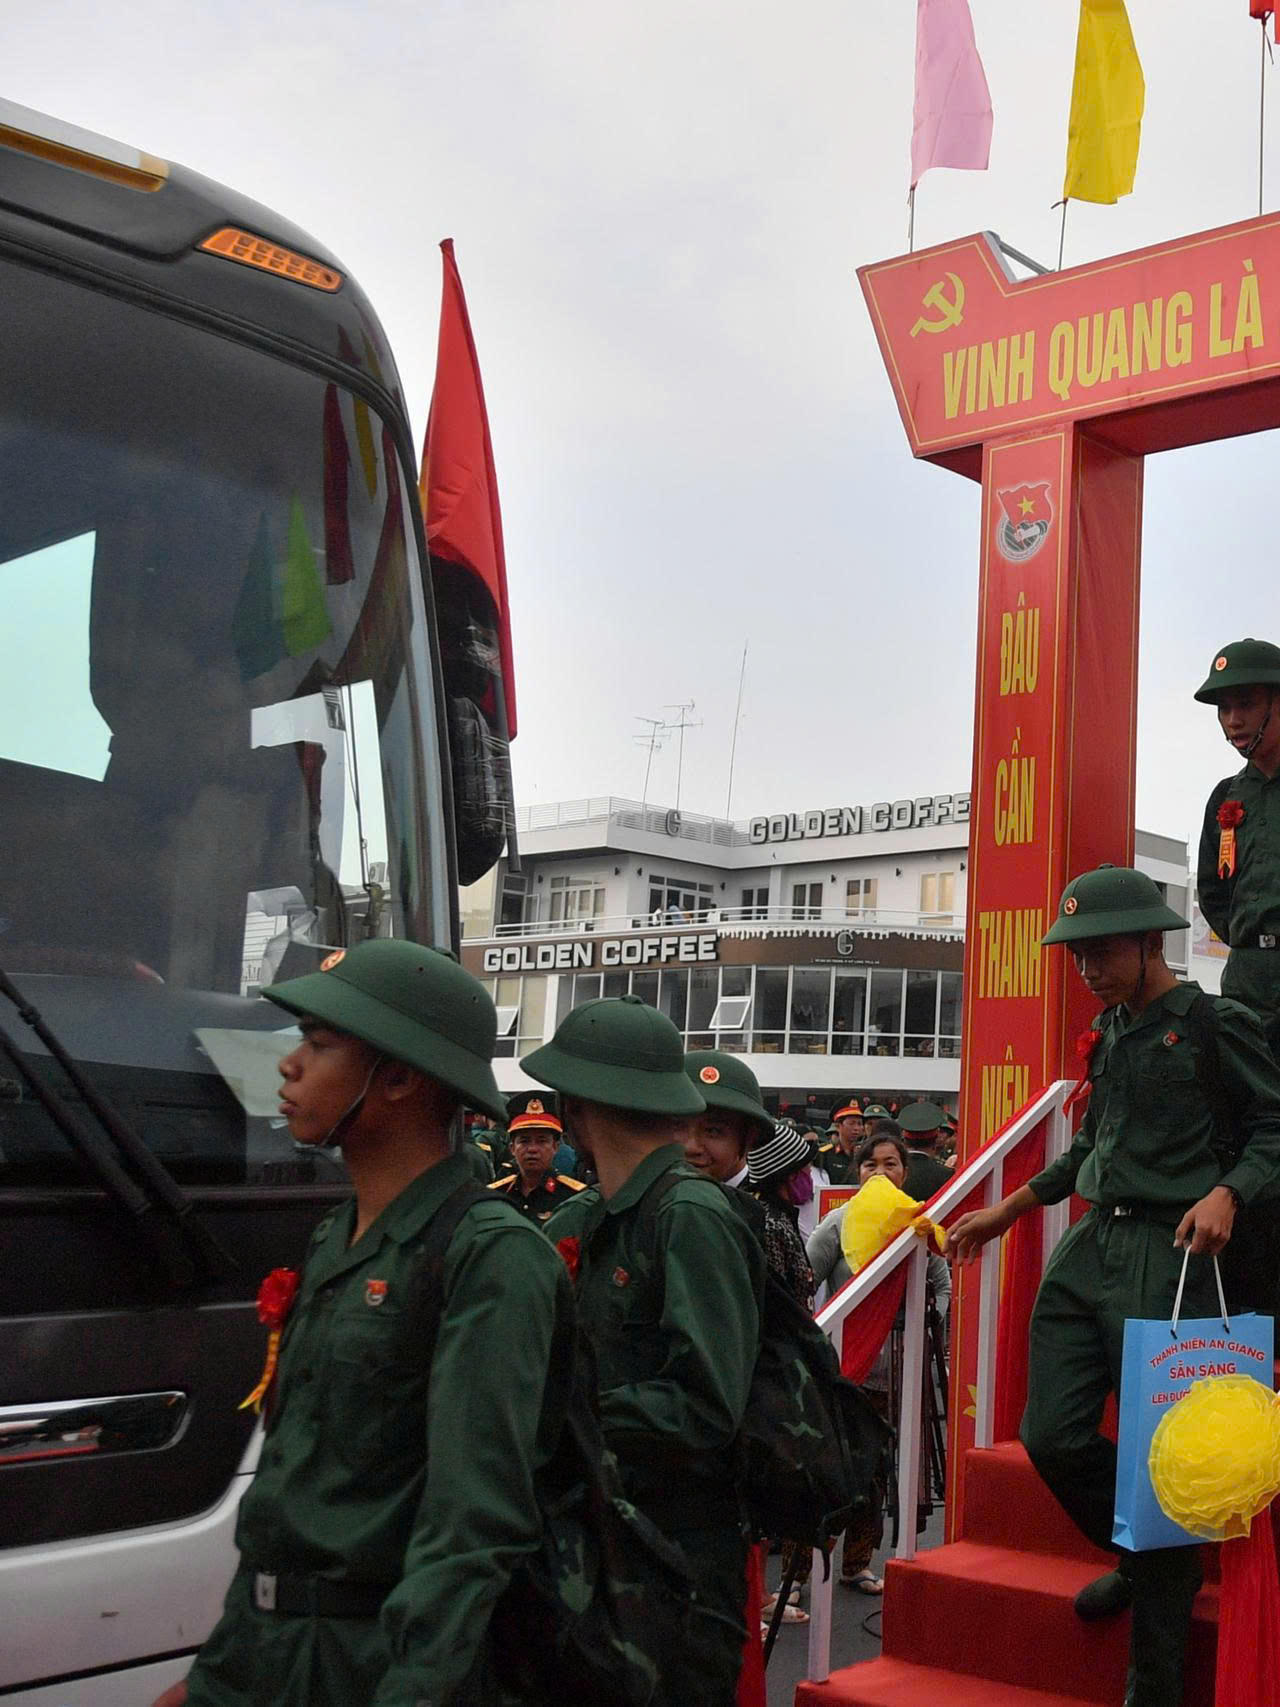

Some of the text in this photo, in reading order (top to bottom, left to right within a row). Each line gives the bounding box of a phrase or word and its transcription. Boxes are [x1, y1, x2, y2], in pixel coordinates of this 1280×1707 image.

[943, 330, 1035, 420] VINH
[1048, 291, 1193, 401] QUANG
[1208, 259, 1265, 358] LÀ
[1000, 591, 1040, 696] ĐÂU
[750, 792, 971, 844] GOLDEN COFFE
[994, 726, 1036, 847] CẦN
[484, 934, 718, 973] GOLDEN COFFEE
[979, 908, 1043, 998] THANH
[1150, 1337, 1265, 1368] THANH NIÊN AN GIANG
[1199, 1360, 1236, 1377] SÀNG
